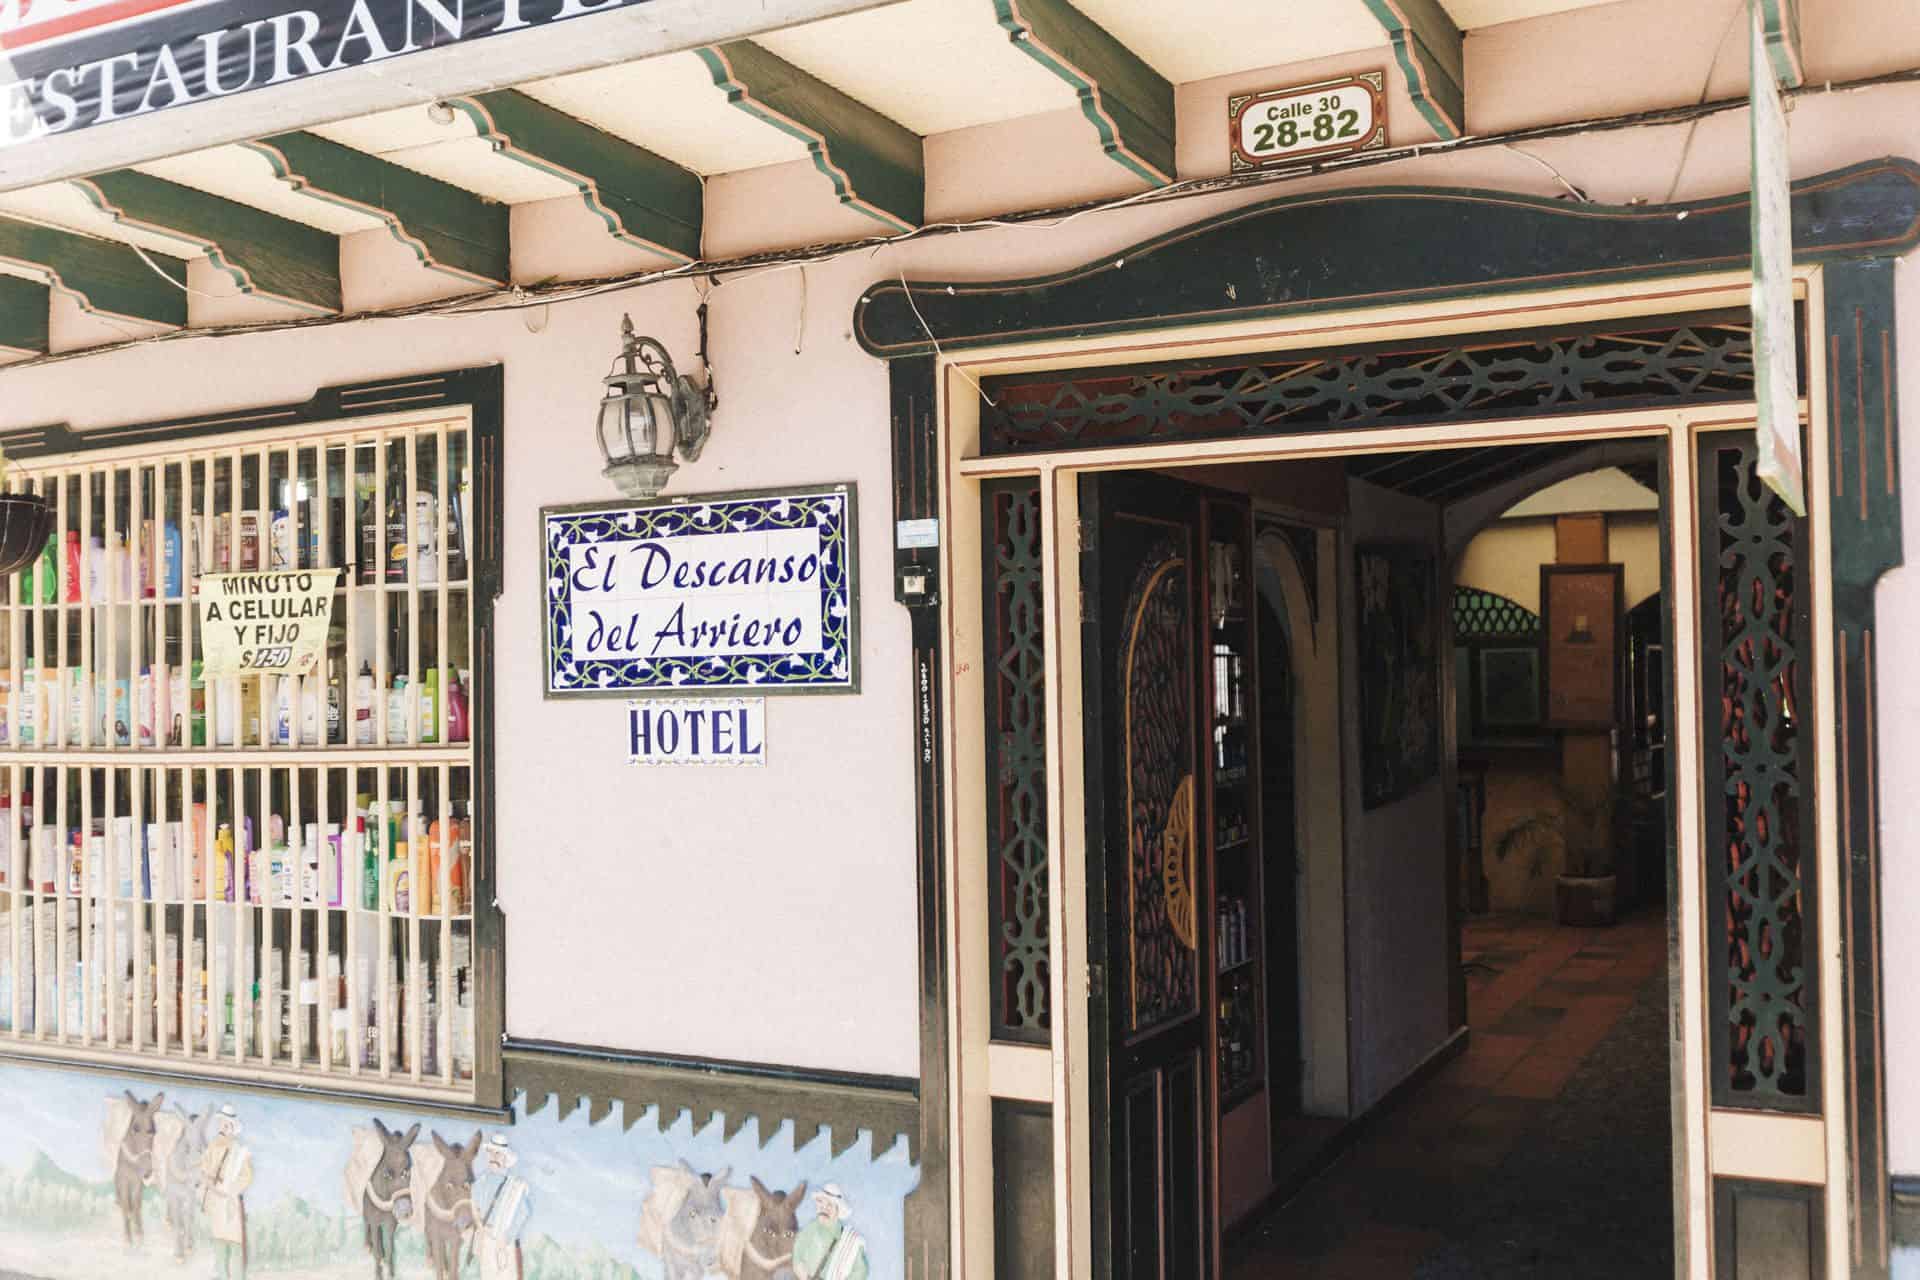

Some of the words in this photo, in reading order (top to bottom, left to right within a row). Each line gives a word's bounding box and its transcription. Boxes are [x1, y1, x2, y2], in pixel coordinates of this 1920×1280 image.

[1266, 102, 1313, 121] Calle
[1319, 95, 1341, 112] 30
[1253, 109, 1360, 152] 28-82
[221, 573, 313, 595] MINUTO
[572, 546, 617, 592] El
[630, 542, 817, 590] Descanso
[206, 601, 223, 622] A
[229, 596, 328, 620] CELULAR
[234, 625, 248, 645] Y
[255, 623, 300, 645] FIJO
[586, 610, 640, 652] del
[651, 601, 803, 655] Arriero
[629, 708, 763, 755] HOTEL
